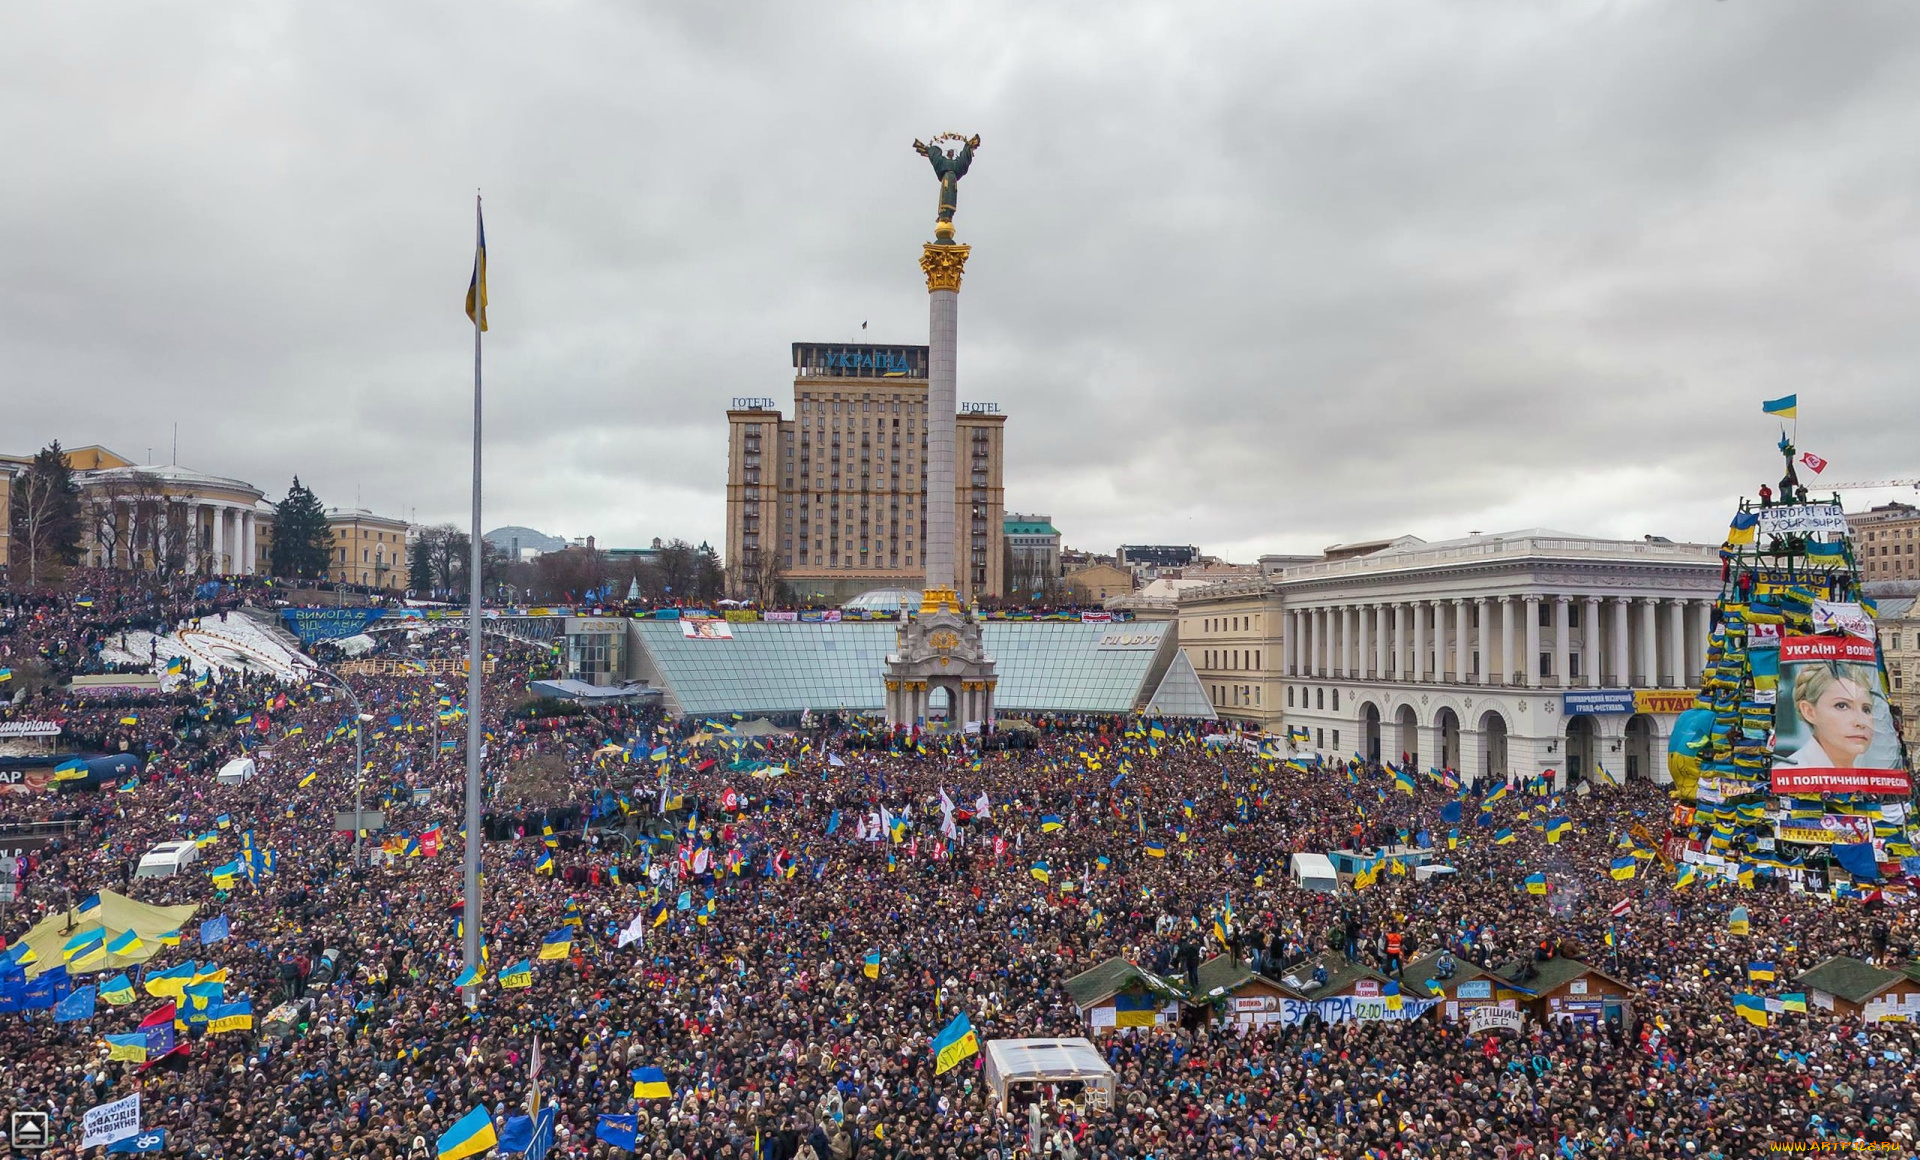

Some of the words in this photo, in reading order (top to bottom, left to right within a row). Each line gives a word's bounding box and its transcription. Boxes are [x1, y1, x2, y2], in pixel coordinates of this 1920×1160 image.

[825, 352, 909, 369] УКРАЇНА
[732, 397, 775, 408] ГОТЕЛЬ
[962, 402, 1001, 413] HOTEL
[1771, 518, 1807, 531] YOUR
[296, 610, 352, 619] ВИМОГА
[1786, 643, 1836, 655] УКРАЇНІ
[1777, 777, 1790, 786] НІ
[1793, 776, 1869, 786] ПОЛІТИЧНИМ
[1284, 998, 1352, 1024] ЗАВТРА
[1355, 1002, 1381, 1019] 12:00
